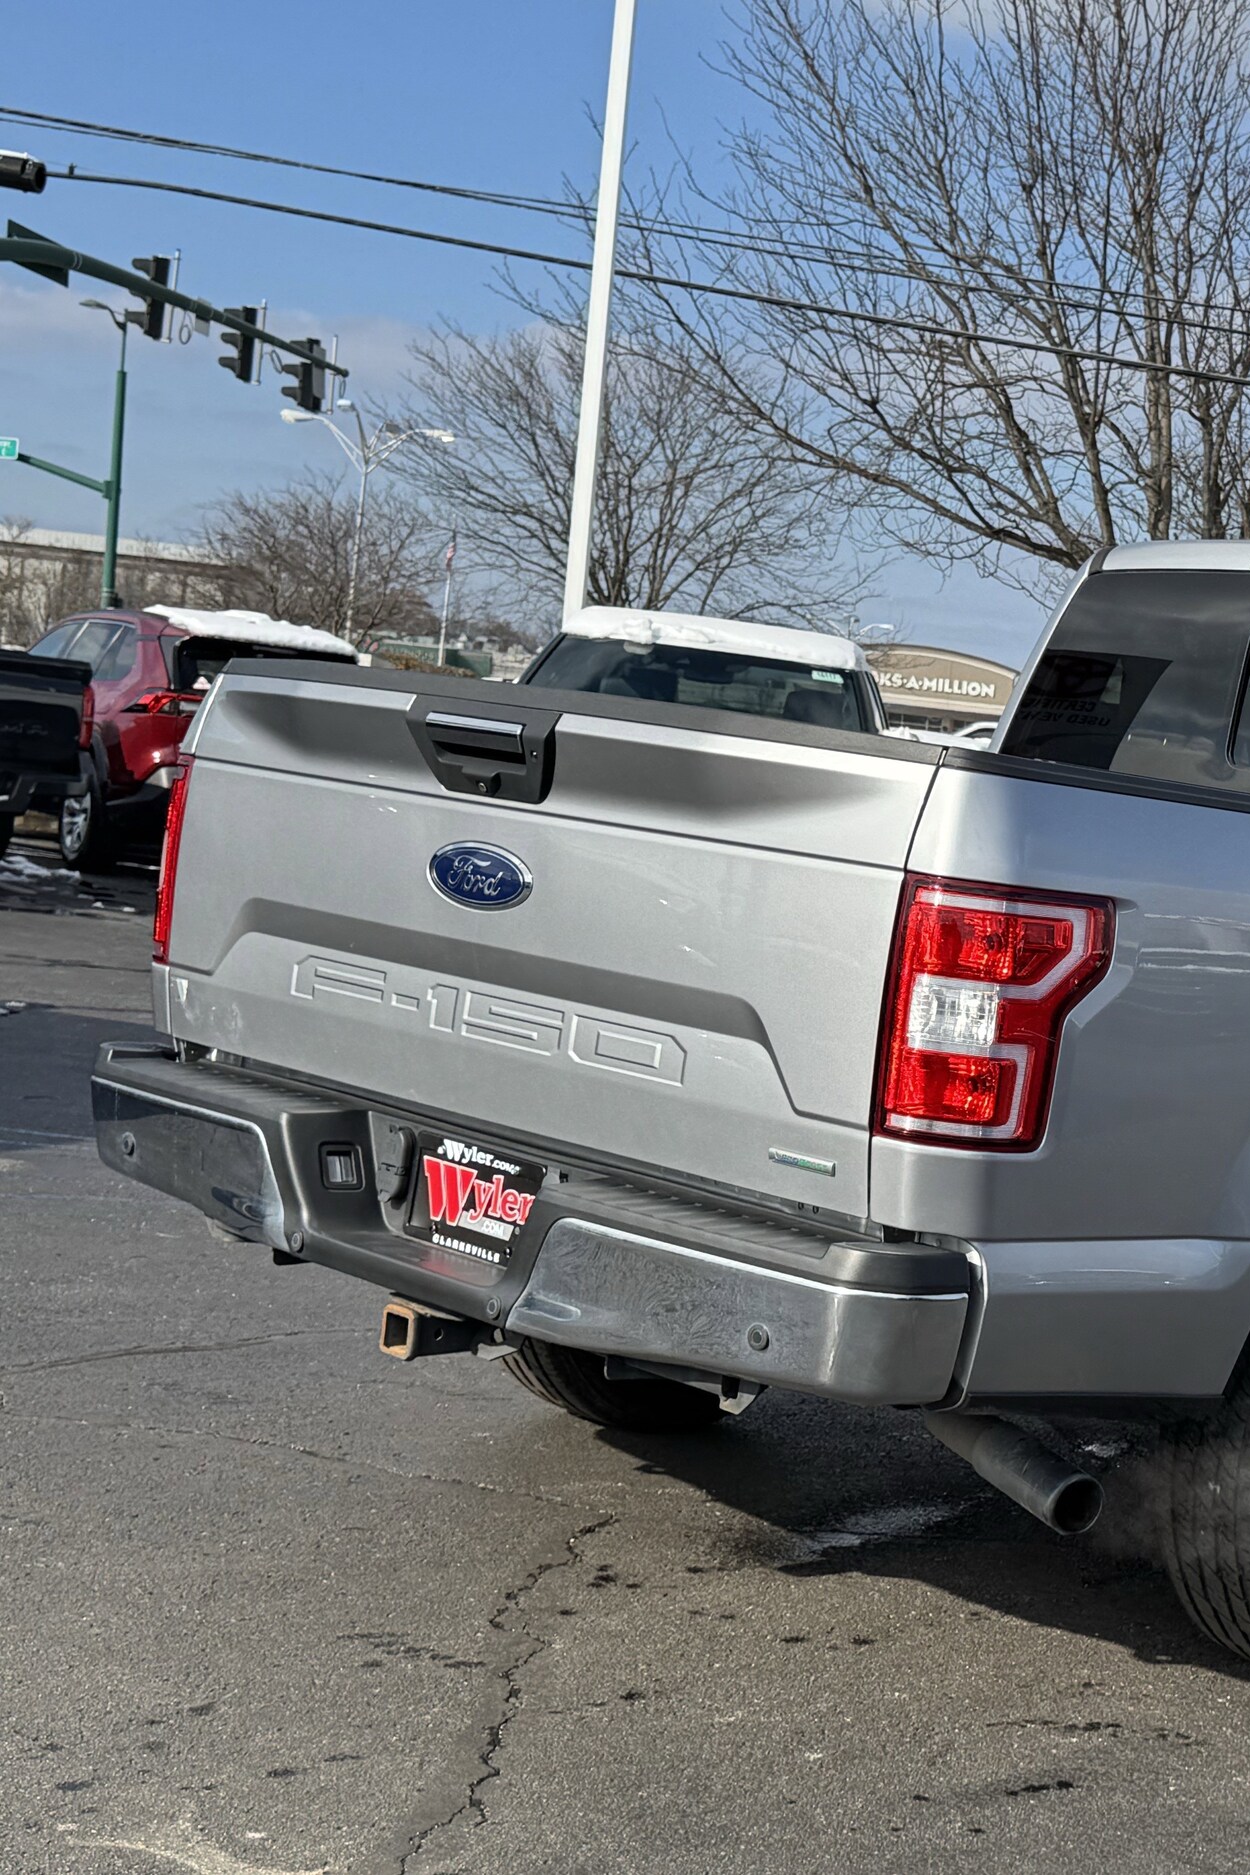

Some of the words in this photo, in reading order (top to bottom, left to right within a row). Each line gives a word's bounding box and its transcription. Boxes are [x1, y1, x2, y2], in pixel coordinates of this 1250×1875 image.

[447, 854, 504, 897] Ford
[291, 955, 687, 1087] F-150
[423, 1155, 536, 1226] Wyler
[432, 1233, 500, 1263] CLARKSVILLE
